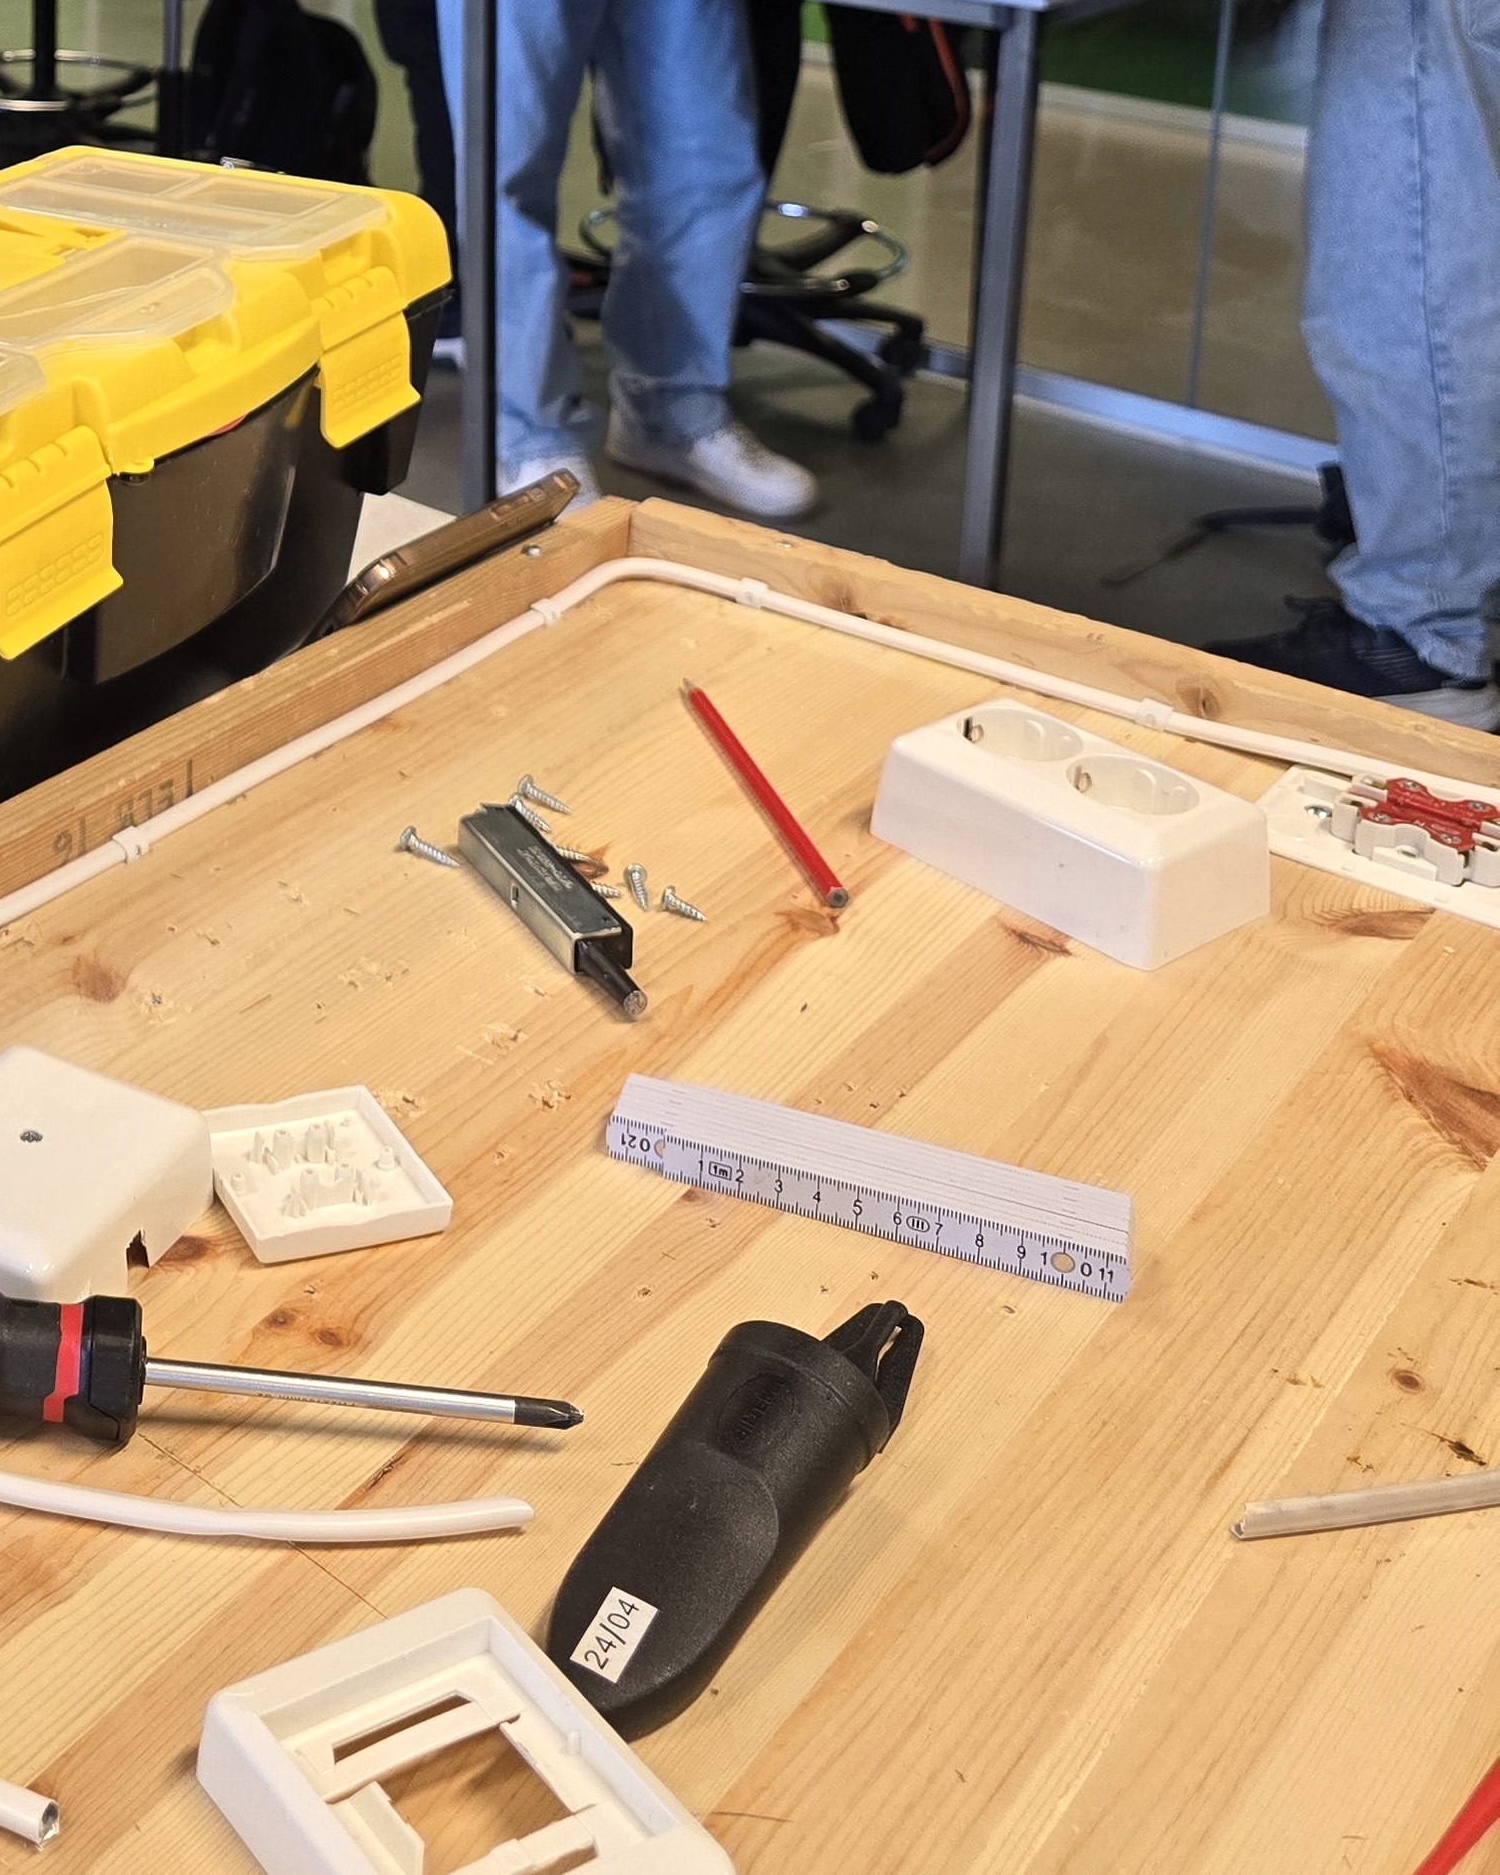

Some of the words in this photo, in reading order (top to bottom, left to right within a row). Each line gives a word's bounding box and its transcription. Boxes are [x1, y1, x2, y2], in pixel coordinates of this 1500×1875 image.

[698, 1160, 704, 1173] 1
[712, 1165, 729, 1178] 1m
[735, 1169, 745, 1183] 2
[773, 1179, 783, 1193] 3
[812, 1190, 822, 1203] 4
[852, 1200, 863, 1216] 5
[892, 1211, 903, 1226] 6
[934, 1222, 944, 1236] 7
[974, 1233, 985, 1248] 8
[1016, 1245, 1027, 1260] 9
[1098, 1267, 1114, 1283] 11
[584, 1598, 639, 1670] 24/04
